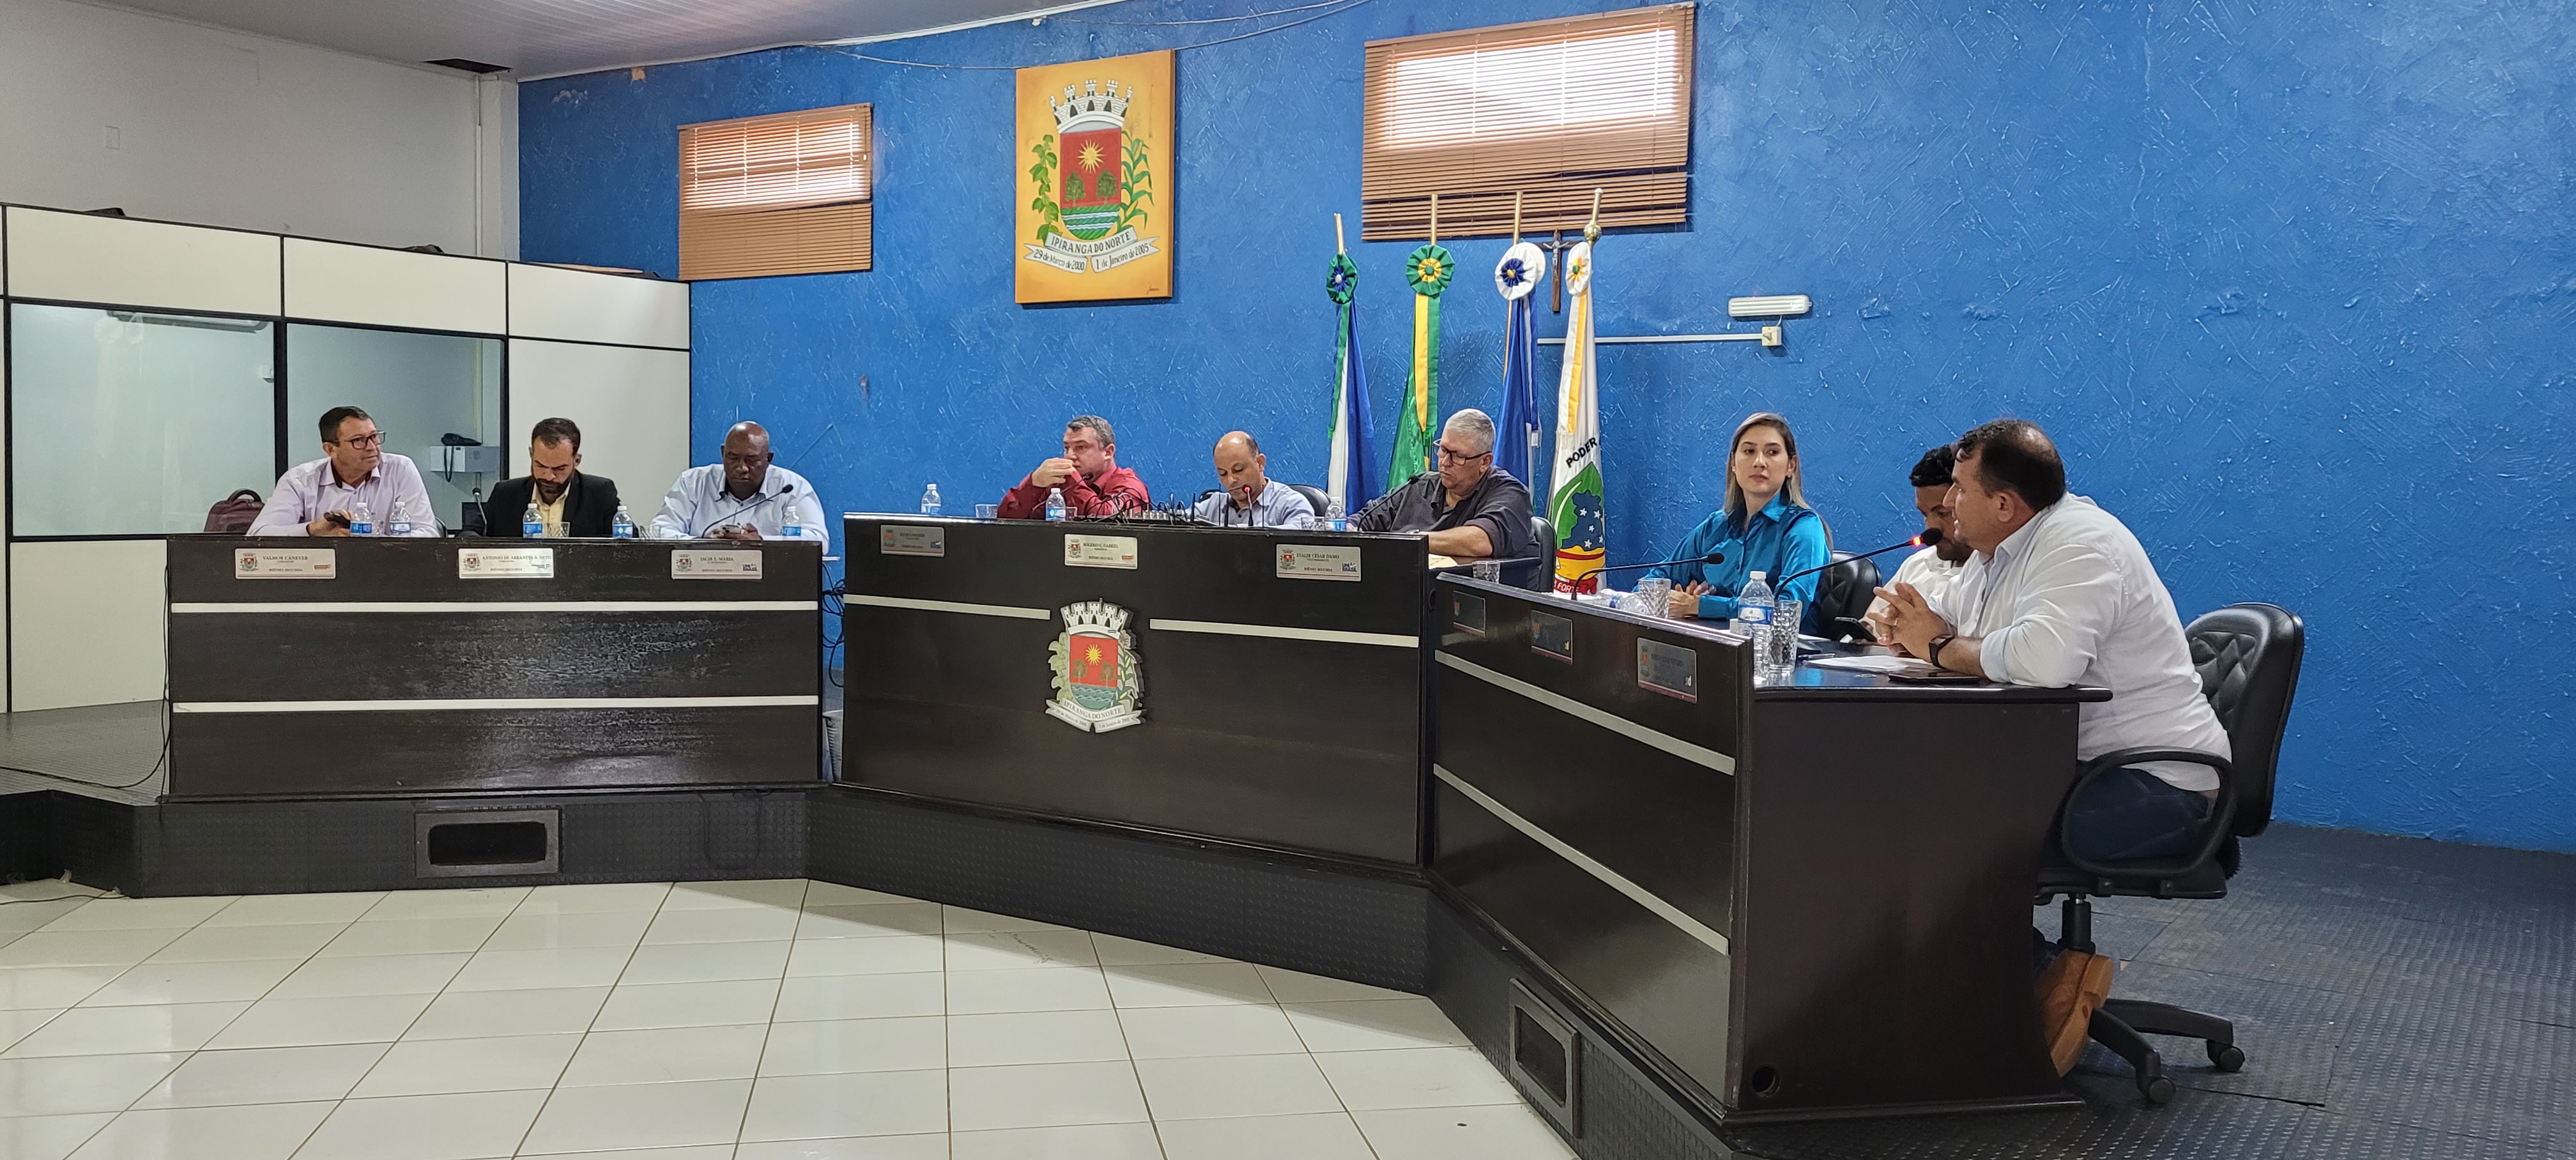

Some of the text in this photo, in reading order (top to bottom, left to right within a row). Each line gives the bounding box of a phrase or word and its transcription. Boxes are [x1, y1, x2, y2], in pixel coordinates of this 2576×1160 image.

[1051, 231, 1131, 254] IPIRANGA DO NORTE
[1033, 248, 1043, 259] 29
[1043, 251, 1049, 261] de
[1071, 260, 1085, 271] 2000
[1096, 259, 1100, 270] 1
[1101, 259, 1108, 268] de
[1128, 249, 1135, 259] de
[1135, 243, 1149, 256] 2005
[1565, 437, 1598, 469] PODER
[1064, 700, 1091, 719] IPIRANGA
[1101, 707, 1122, 718] NORTE
